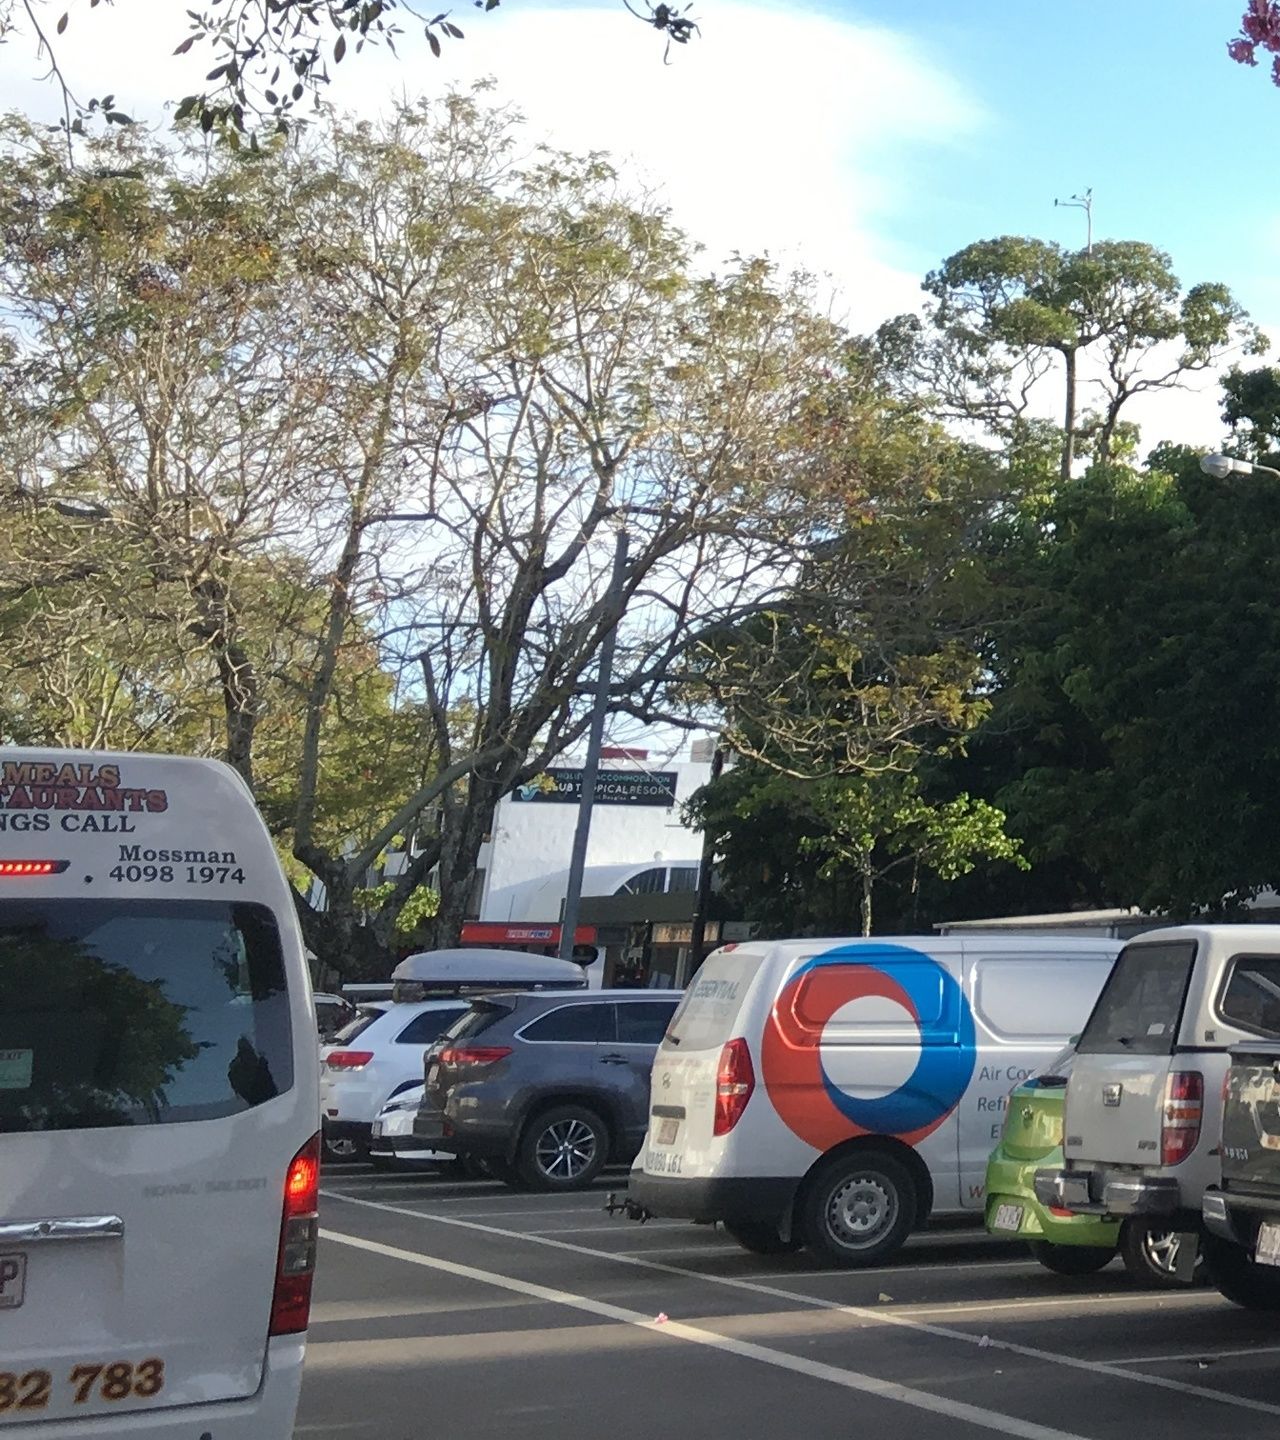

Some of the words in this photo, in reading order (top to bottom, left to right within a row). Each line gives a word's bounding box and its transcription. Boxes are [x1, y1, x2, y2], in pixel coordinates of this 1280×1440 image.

[2, 761, 122, 789] MEALS
[60, 814, 136, 833] CALL
[118, 845, 237, 865] Mossman
[109, 865, 175, 884] 4098
[186, 867, 247, 885] 1974
[979, 1067, 1001, 1082] Air
[69, 1354, 166, 1405] 783
